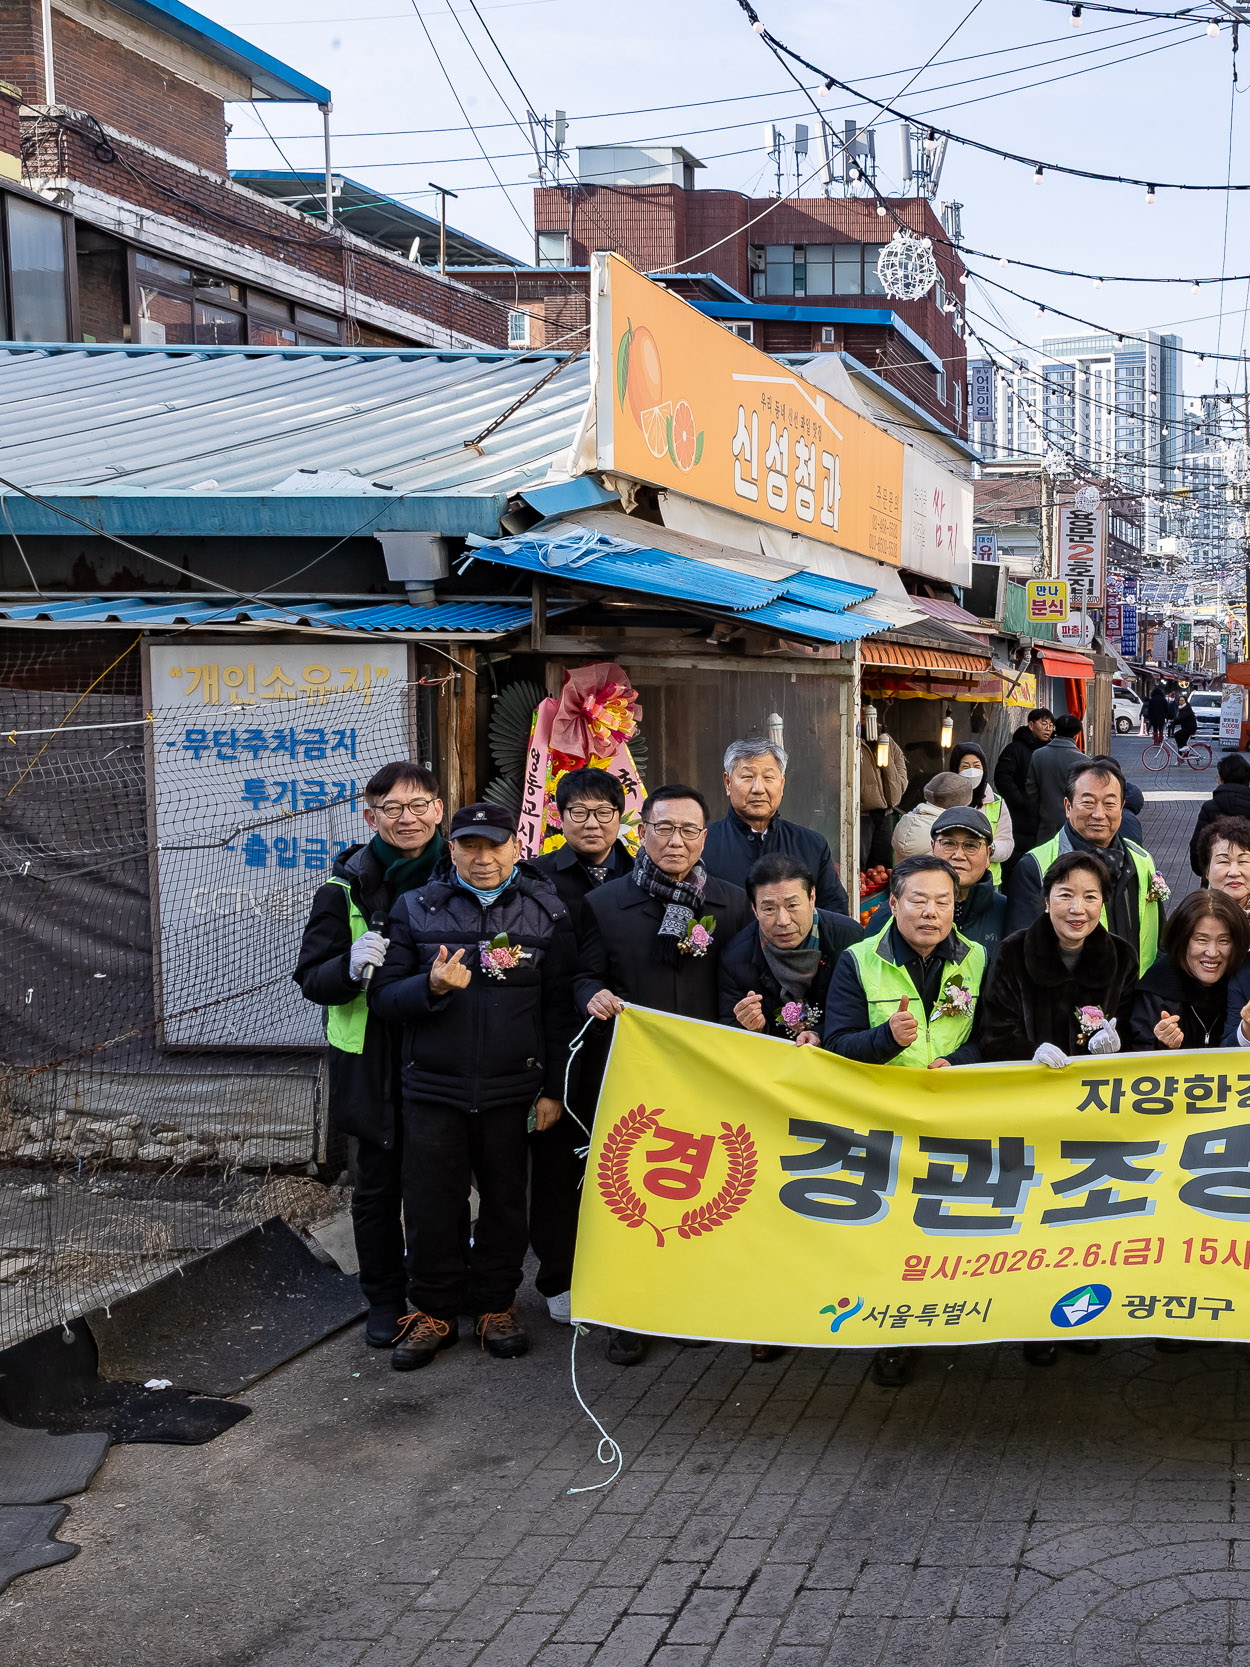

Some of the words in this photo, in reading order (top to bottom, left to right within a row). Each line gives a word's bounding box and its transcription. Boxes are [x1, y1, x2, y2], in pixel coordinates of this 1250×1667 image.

[761, 392, 772, 415] 우리
[775, 400, 786, 423] 동네
[976, 375, 989, 416] 어린이집
[732, 404, 842, 532] 신성청과
[1066, 509, 1097, 596] 용문2호집
[1032, 599, 1064, 617] 분식
[1036, 586, 1059, 597] 만나
[241, 779, 357, 813] 투기금지
[645, 1125, 715, 1201] 경
[862, 1297, 993, 1329] 서울특별시
[1122, 1295, 1235, 1321] 광진구
